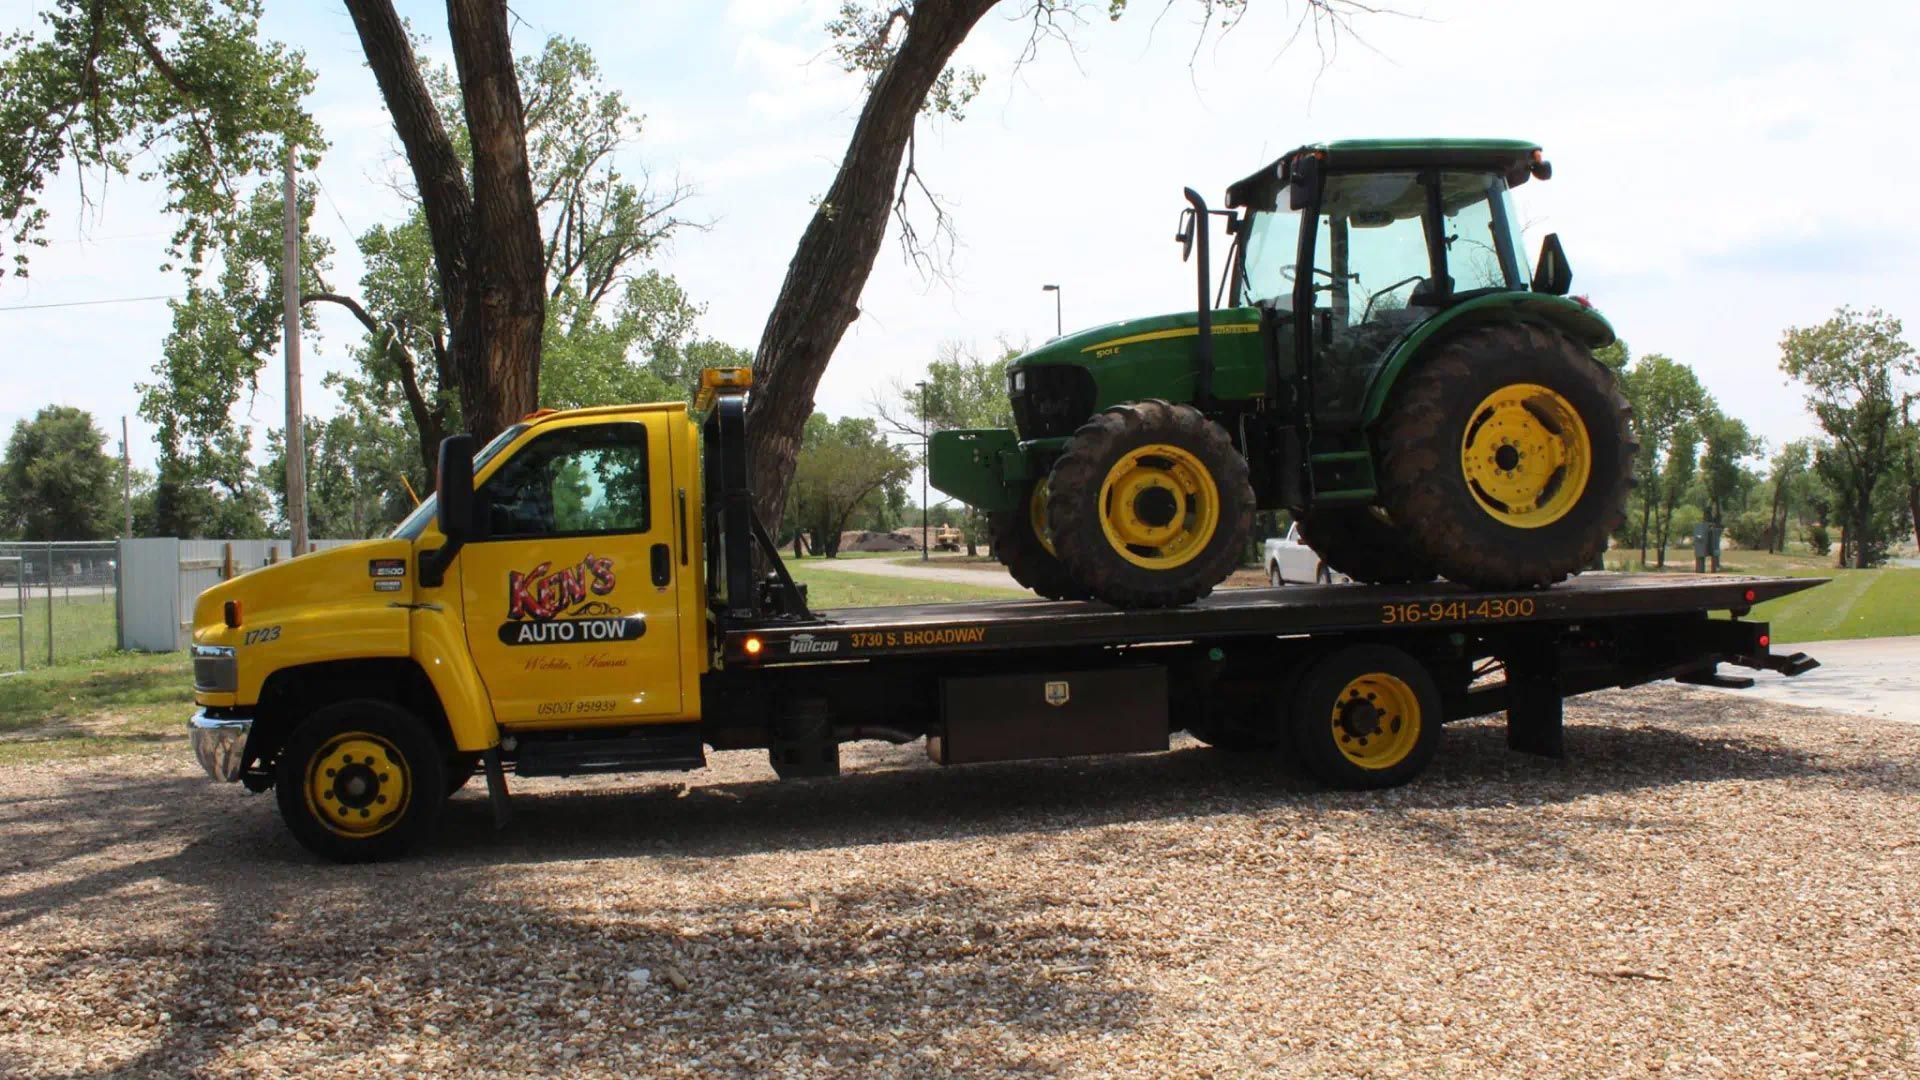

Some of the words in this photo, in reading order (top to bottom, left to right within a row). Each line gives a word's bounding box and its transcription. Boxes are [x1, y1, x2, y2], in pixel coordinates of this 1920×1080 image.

[1382, 598, 1534, 624] 316-941-4300
[245, 625, 282, 646] 1723
[518, 622, 574, 642] AUTO
[579, 620, 626, 639] TOW
[851, 632, 883, 648] 3730
[887, 632, 900, 647] S.
[904, 628, 985, 645] BROADWAY
[538, 702, 574, 715] USDOT
